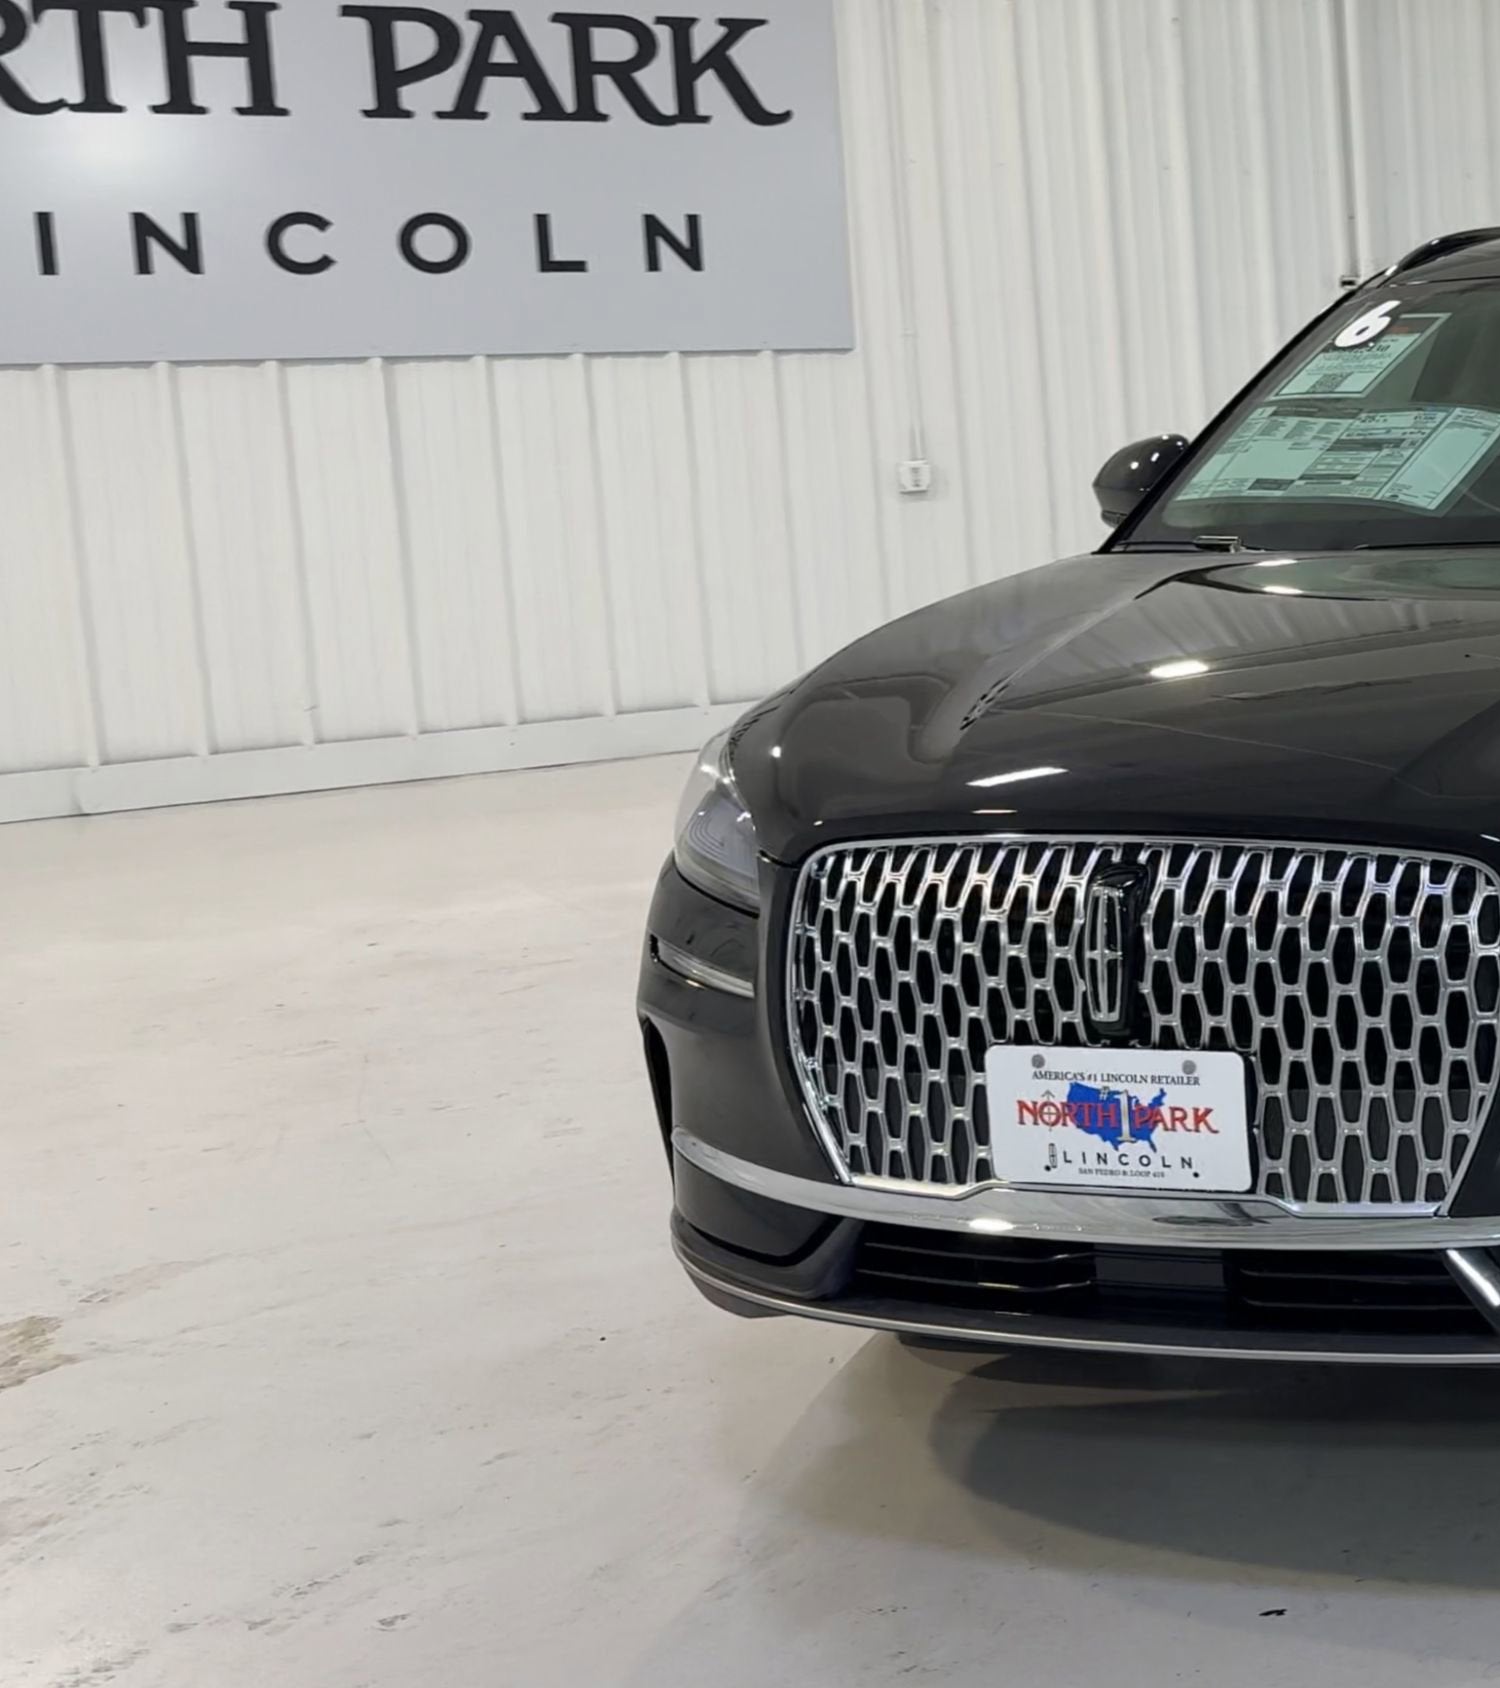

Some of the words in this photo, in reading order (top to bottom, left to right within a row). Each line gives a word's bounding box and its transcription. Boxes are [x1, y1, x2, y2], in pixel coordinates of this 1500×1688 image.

[340, 4, 794, 128] PARK
[1032, 1070, 1085, 1082] AMERICA'S
[1100, 1073, 1148, 1084] LINCOLN
[1150, 1074, 1200, 1086] RETAILER
[1016, 1099, 1119, 1128] NORTH
[1133, 1104, 1220, 1134] PARK
[1063, 1150, 1193, 1169] LINCOLN
